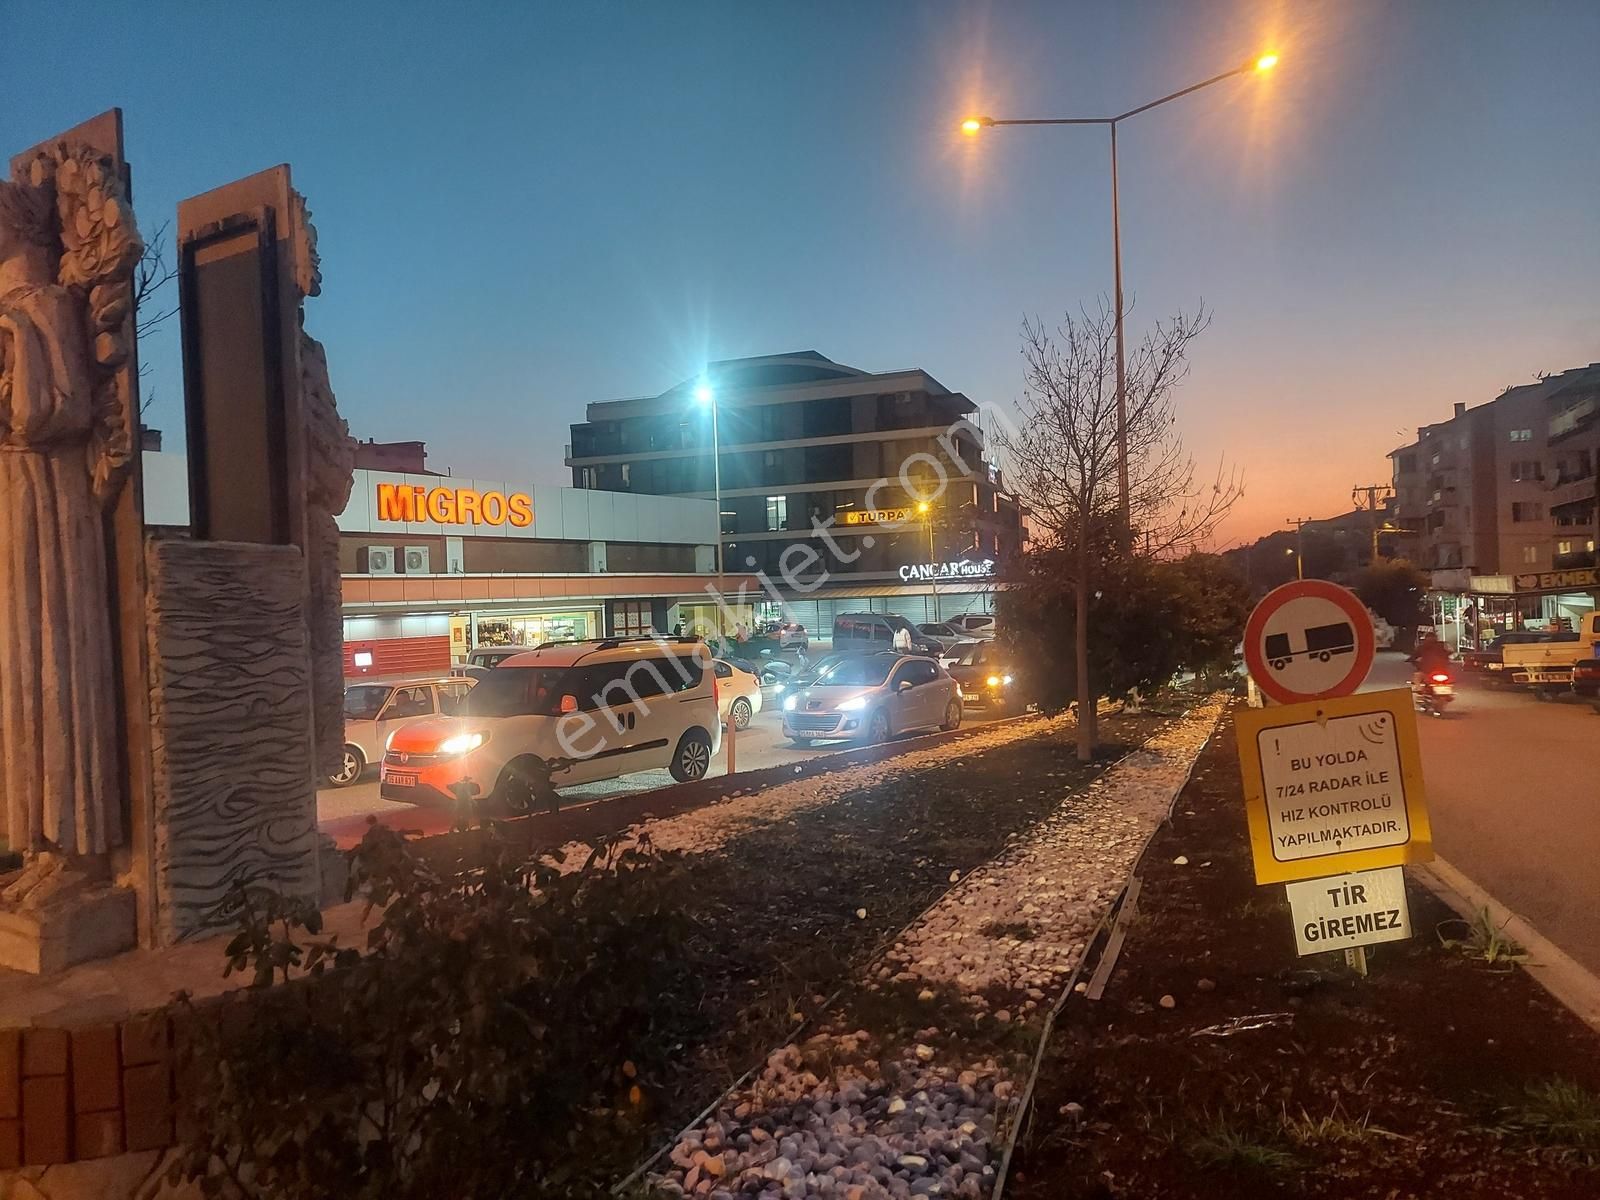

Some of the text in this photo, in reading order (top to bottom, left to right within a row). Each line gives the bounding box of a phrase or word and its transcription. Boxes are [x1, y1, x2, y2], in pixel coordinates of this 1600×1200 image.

[961, 563, 993, 576] HOUSE
[1540, 570, 1598, 589] EKMEK
[1291, 750, 1368, 772] BU YOLDA
[1276, 771, 1390, 798] 7/24 RADAR İLE
[1281, 794, 1392, 823] HIZ KONTROLÜ
[1278, 820, 1402, 848] YAPILMAKTADIR.
[1327, 881, 1368, 908] TİR
[1304, 909, 1402, 942] GİREMEZ
